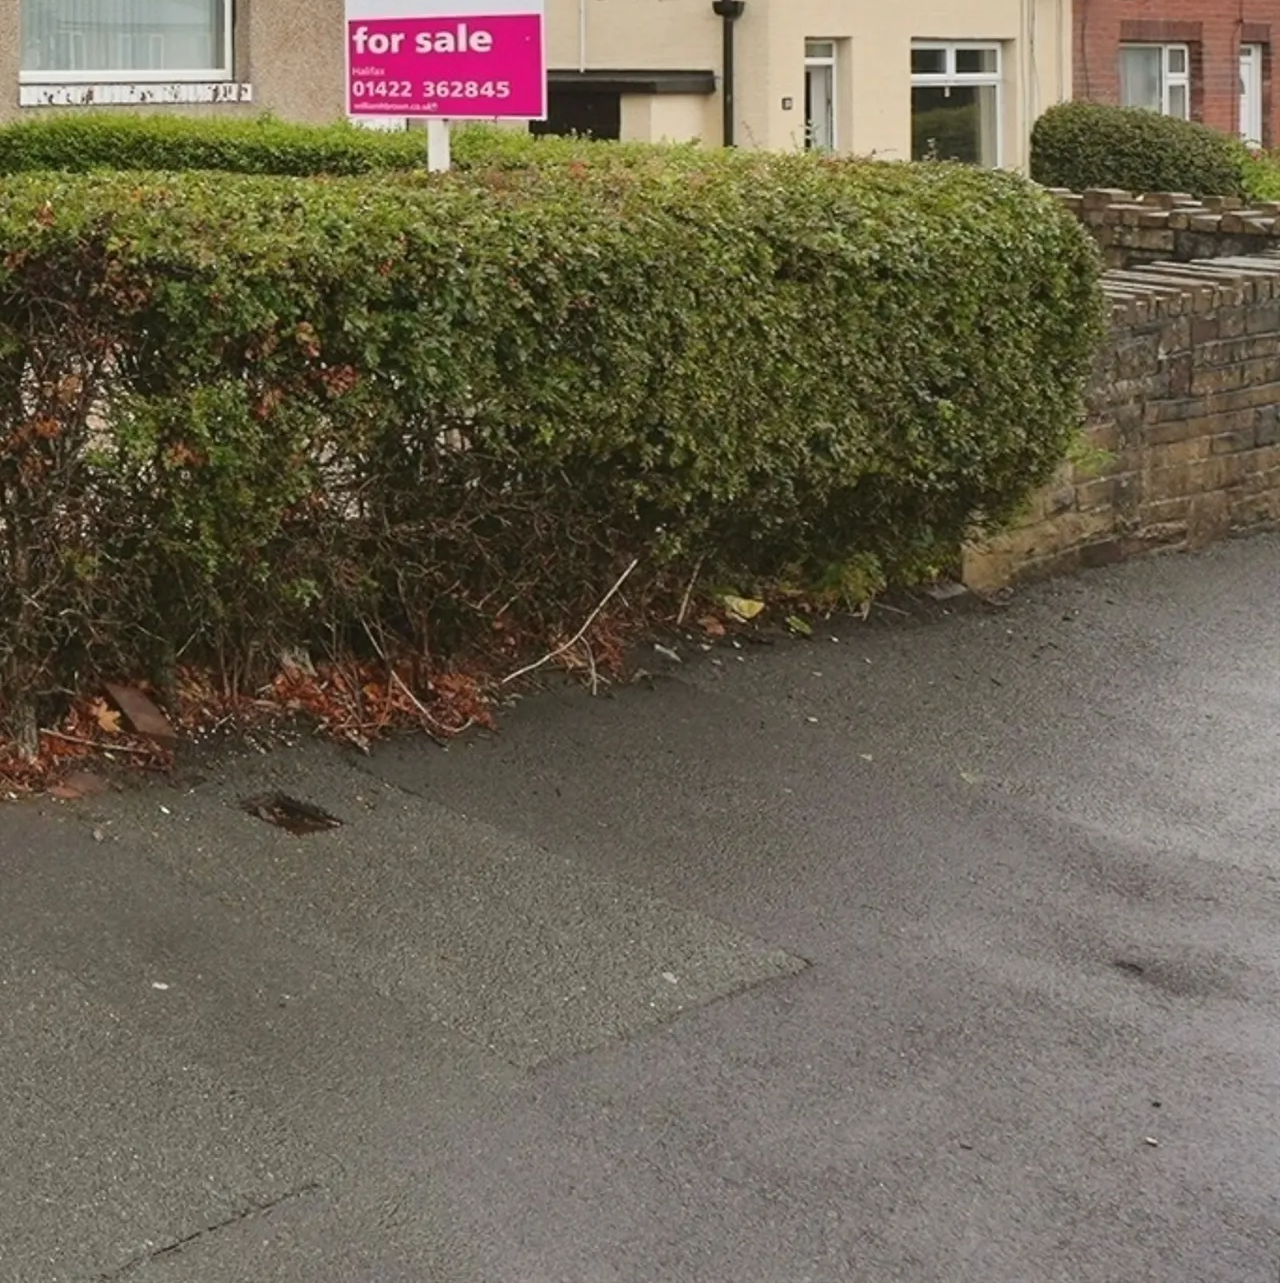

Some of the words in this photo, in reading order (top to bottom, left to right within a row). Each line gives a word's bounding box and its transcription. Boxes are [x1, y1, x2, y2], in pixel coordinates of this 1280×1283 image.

[351, 26, 405, 55] for
[414, 23, 494, 54] sale
[351, 65, 386, 77] Halifax
[351, 80, 413, 98] 01422
[423, 80, 511, 98] 362845
